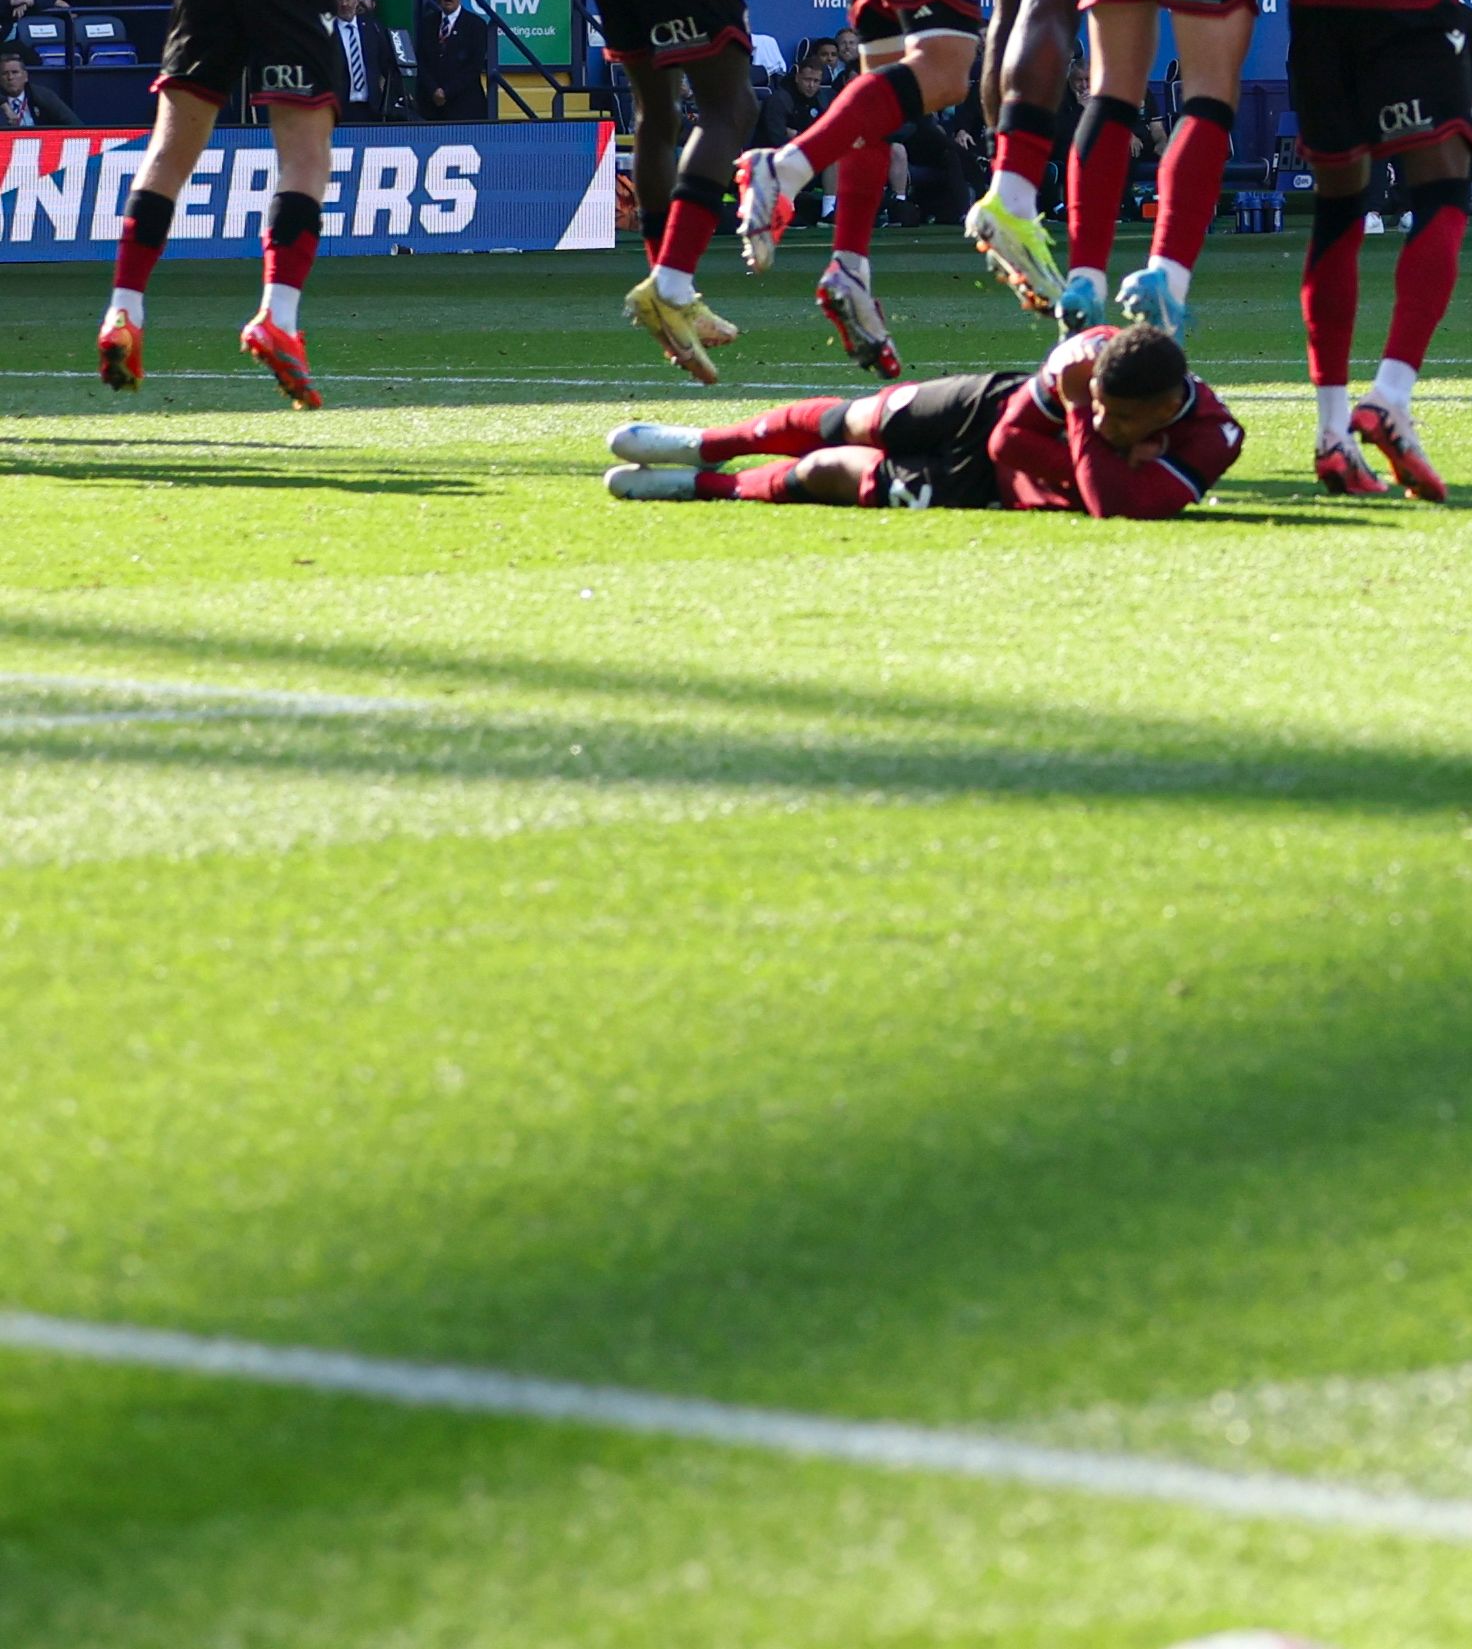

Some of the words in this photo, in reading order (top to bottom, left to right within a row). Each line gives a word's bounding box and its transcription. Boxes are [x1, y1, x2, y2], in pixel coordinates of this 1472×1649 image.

[651, 16, 708, 48] CRL
[262, 65, 313, 90] CRL
[1379, 99, 1431, 132] CRL
